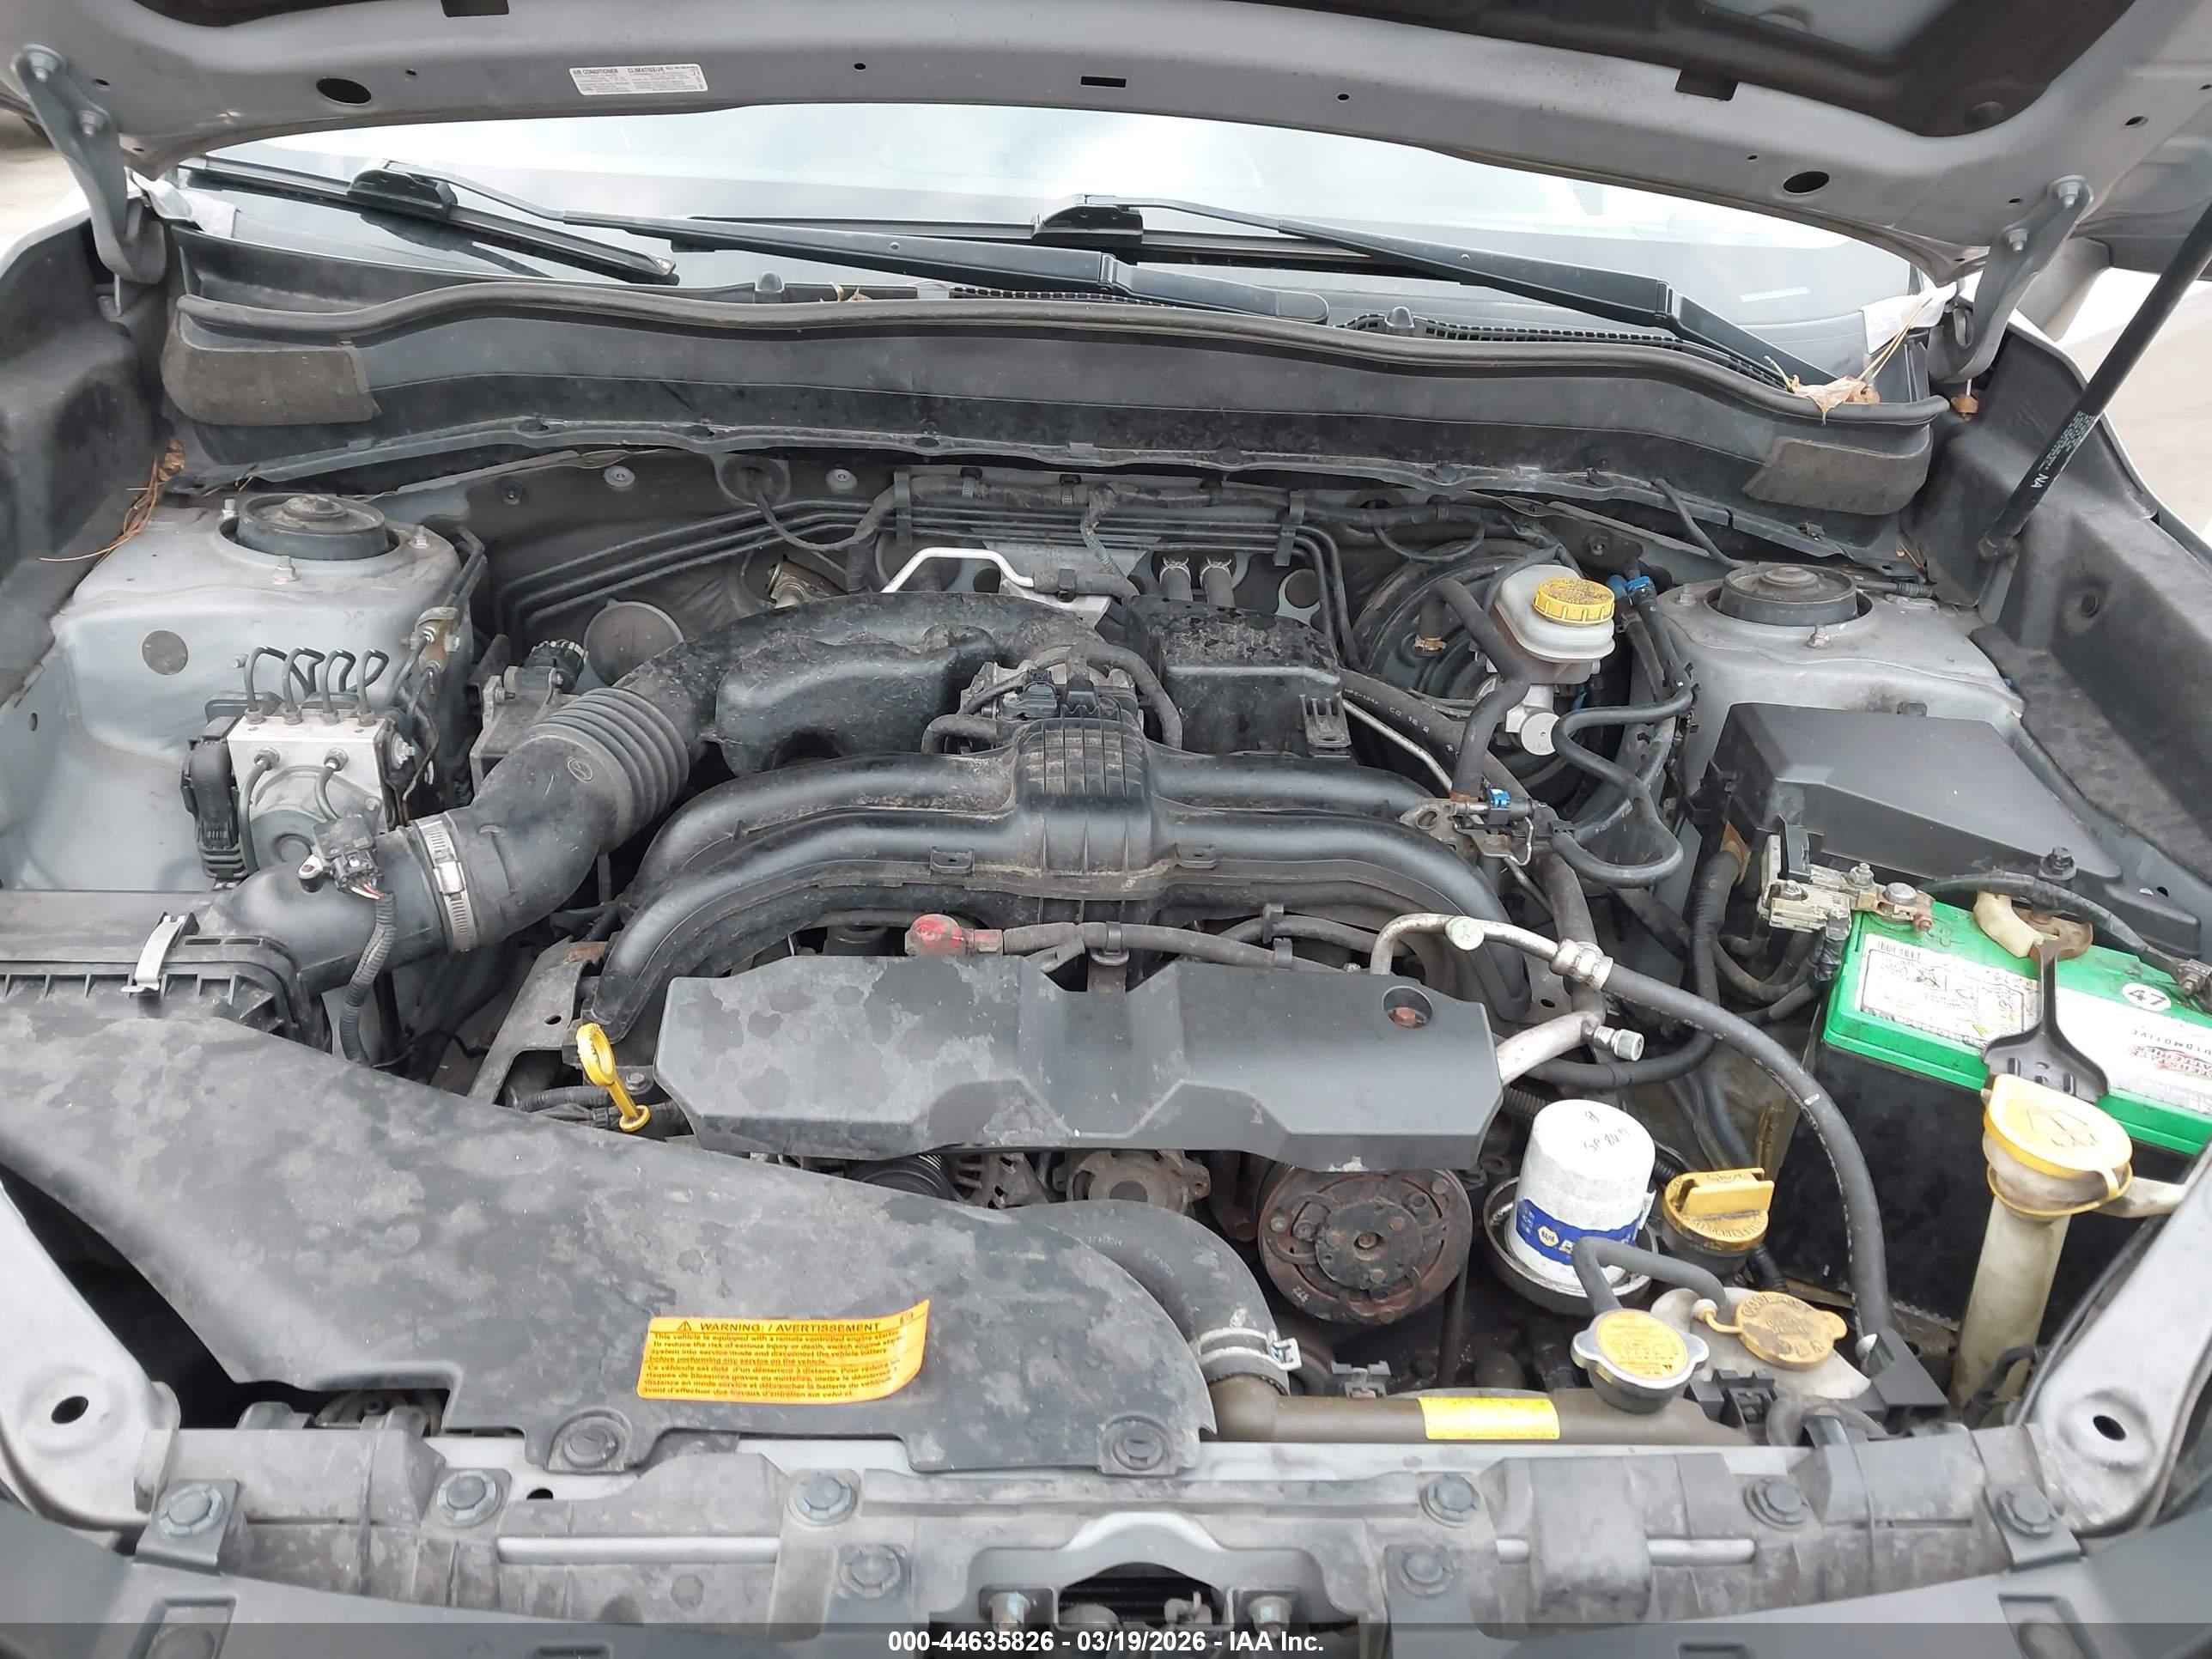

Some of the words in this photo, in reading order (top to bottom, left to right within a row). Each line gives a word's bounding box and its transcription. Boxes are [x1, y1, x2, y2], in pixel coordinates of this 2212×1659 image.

[2031, 473, 2049, 488] NA
[2129, 989, 2166, 1006] 47
[2132, 1029, 2212, 1056] UTOMOTIVE
[2130, 1050, 2212, 1079] TERSTATE
[2137, 1044, 2212, 1071] ATTERIES
[775, 1322, 880, 1332] AVERTISSEMENT
